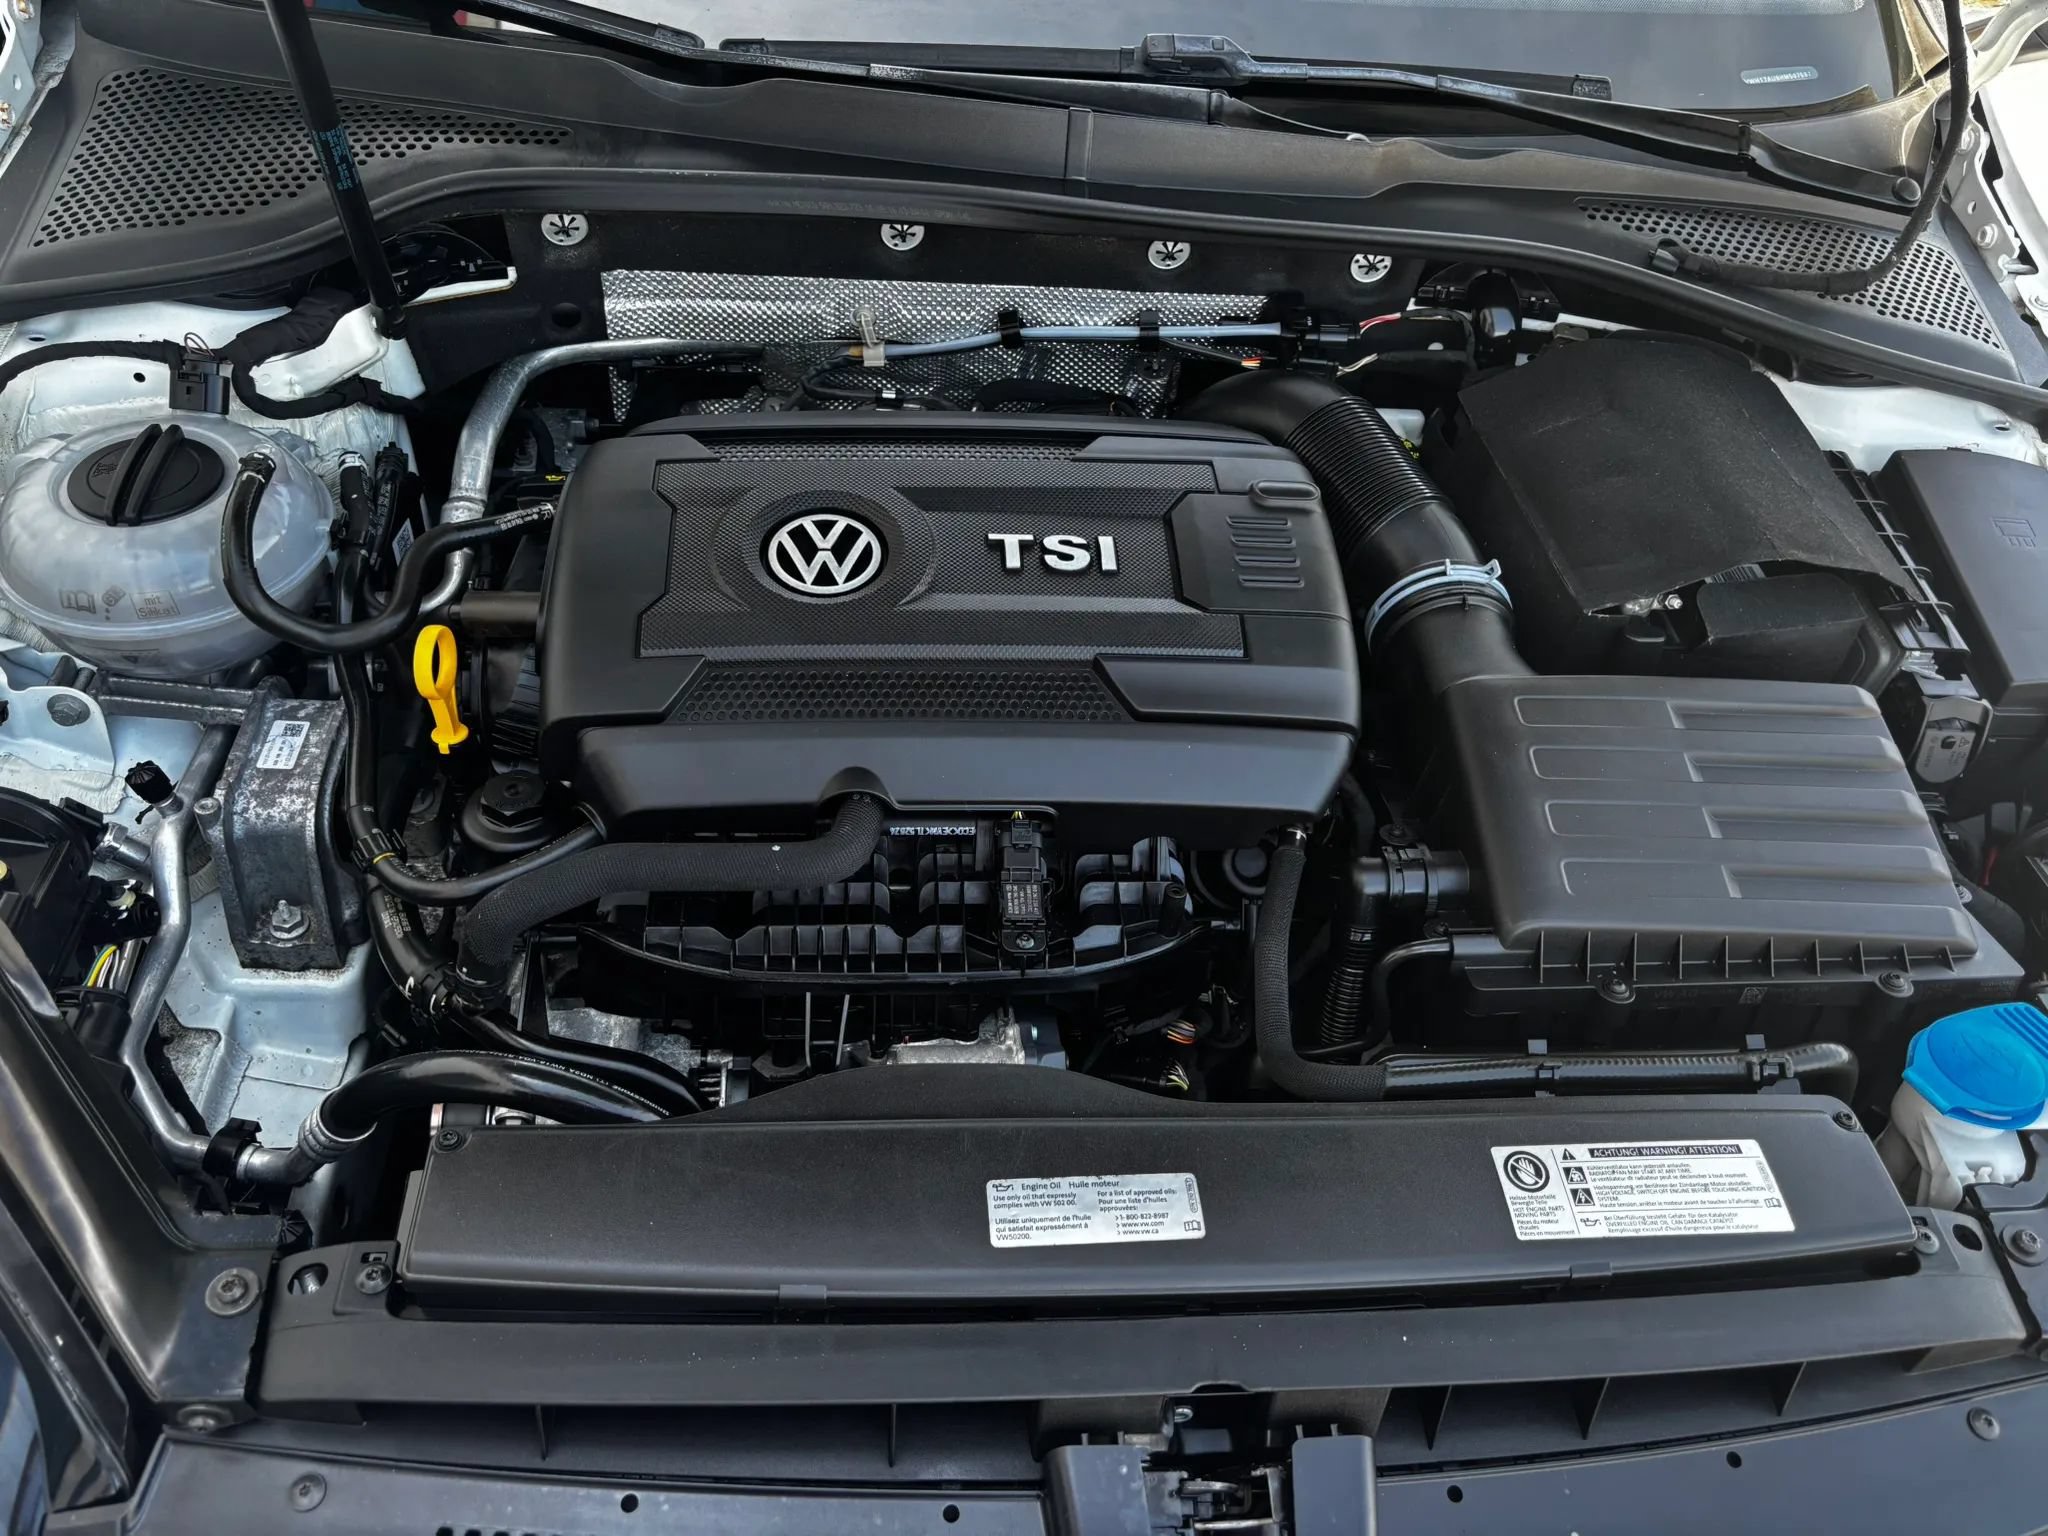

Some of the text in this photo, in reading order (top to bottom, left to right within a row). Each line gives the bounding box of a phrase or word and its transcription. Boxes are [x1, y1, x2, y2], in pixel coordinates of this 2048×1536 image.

[768, 513, 882, 595] VW
[987, 532, 1120, 574] TSI
[1593, 1145, 1739, 1157] ACHTUNG! WARNING! ATTENTION!
[1022, 1183, 1048, 1192] Engine
[1091, 1180, 1120, 1188] moteur
[1133, 1188, 1162, 1197] approved
[994, 1202, 1022, 1210] complies
[1021, 1216, 1060, 1225] uniquement
[996, 1225, 1006, 1234] qui
[1035, 1223, 1082, 1232] expressément
